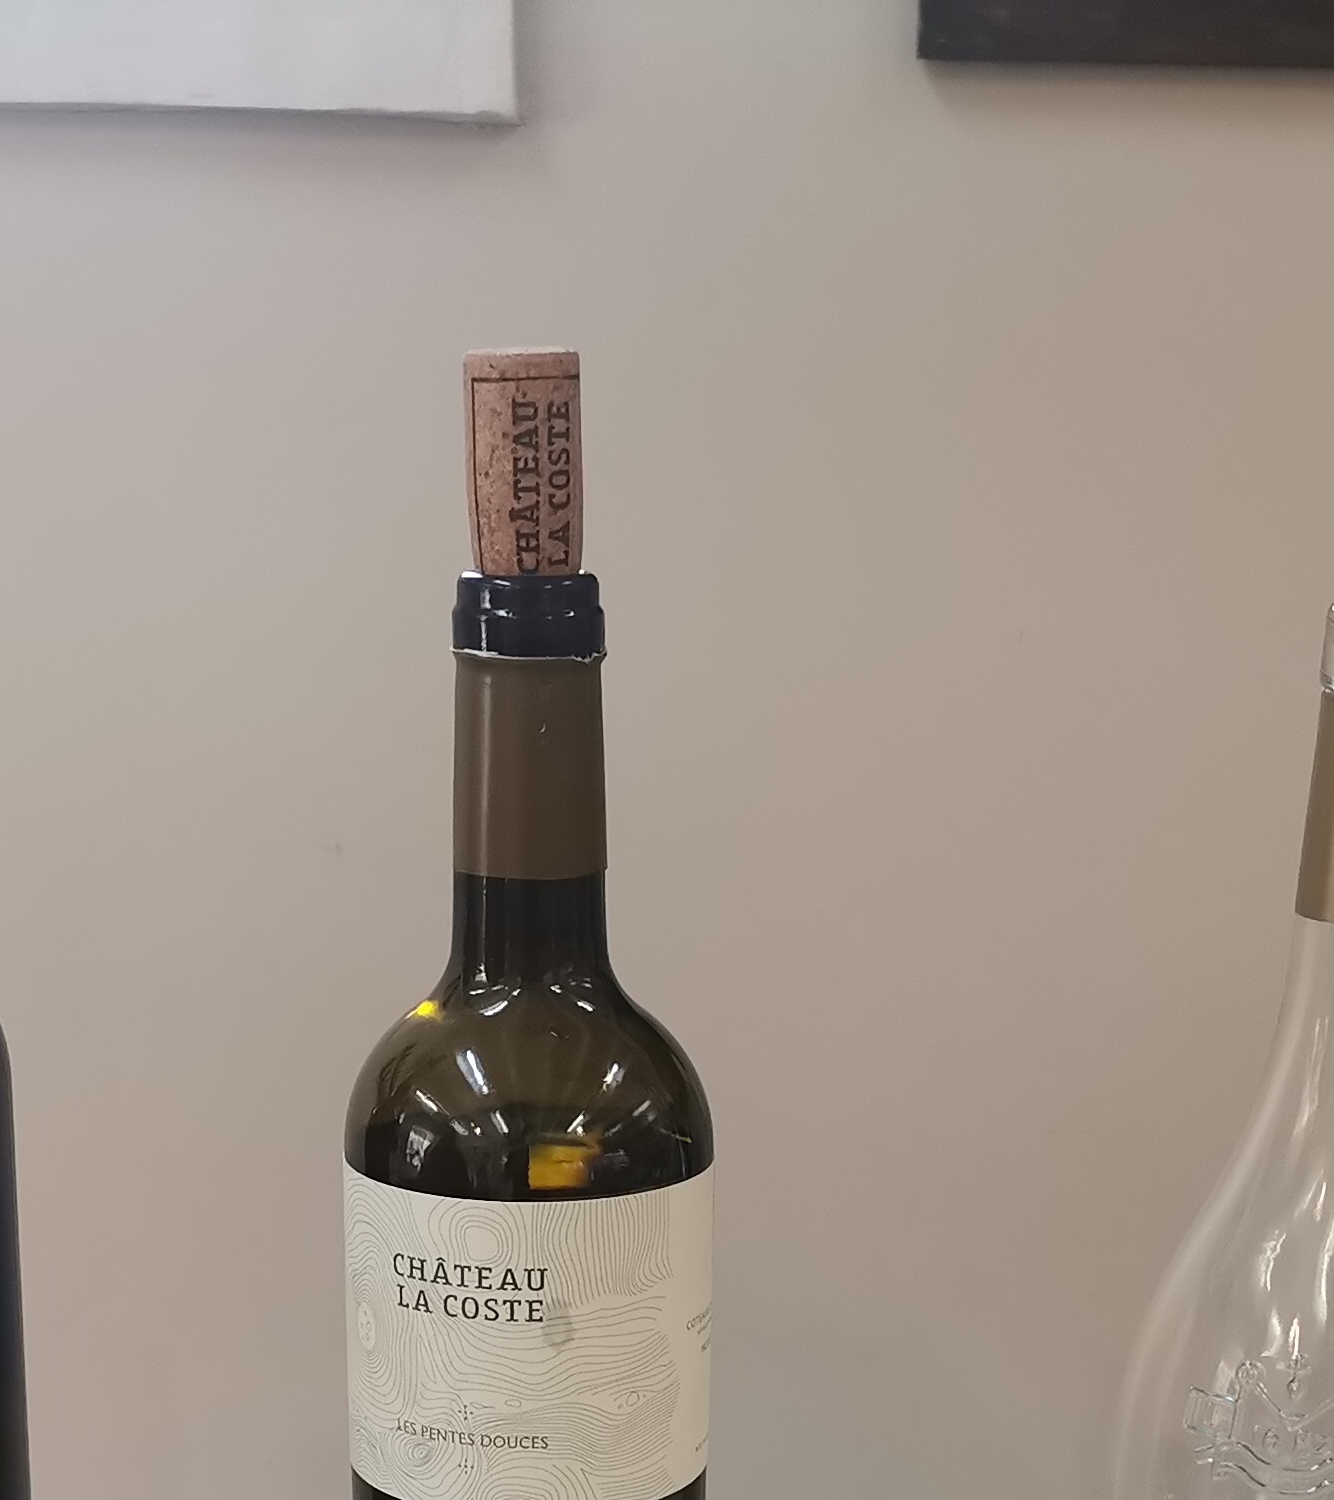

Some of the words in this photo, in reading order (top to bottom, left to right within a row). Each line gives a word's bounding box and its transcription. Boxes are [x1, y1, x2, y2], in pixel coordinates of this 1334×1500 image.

[547, 400, 571, 516] COSTE
[547, 520, 571, 568] LA
[393, 1252, 549, 1292] CHÂTEAU
[396, 1283, 433, 1314] LA
[443, 1294, 544, 1323] COSTE
[396, 1417, 417, 1437] LES
[420, 1424, 476, 1447] PENTES
[479, 1433, 550, 1450] DOUCES
